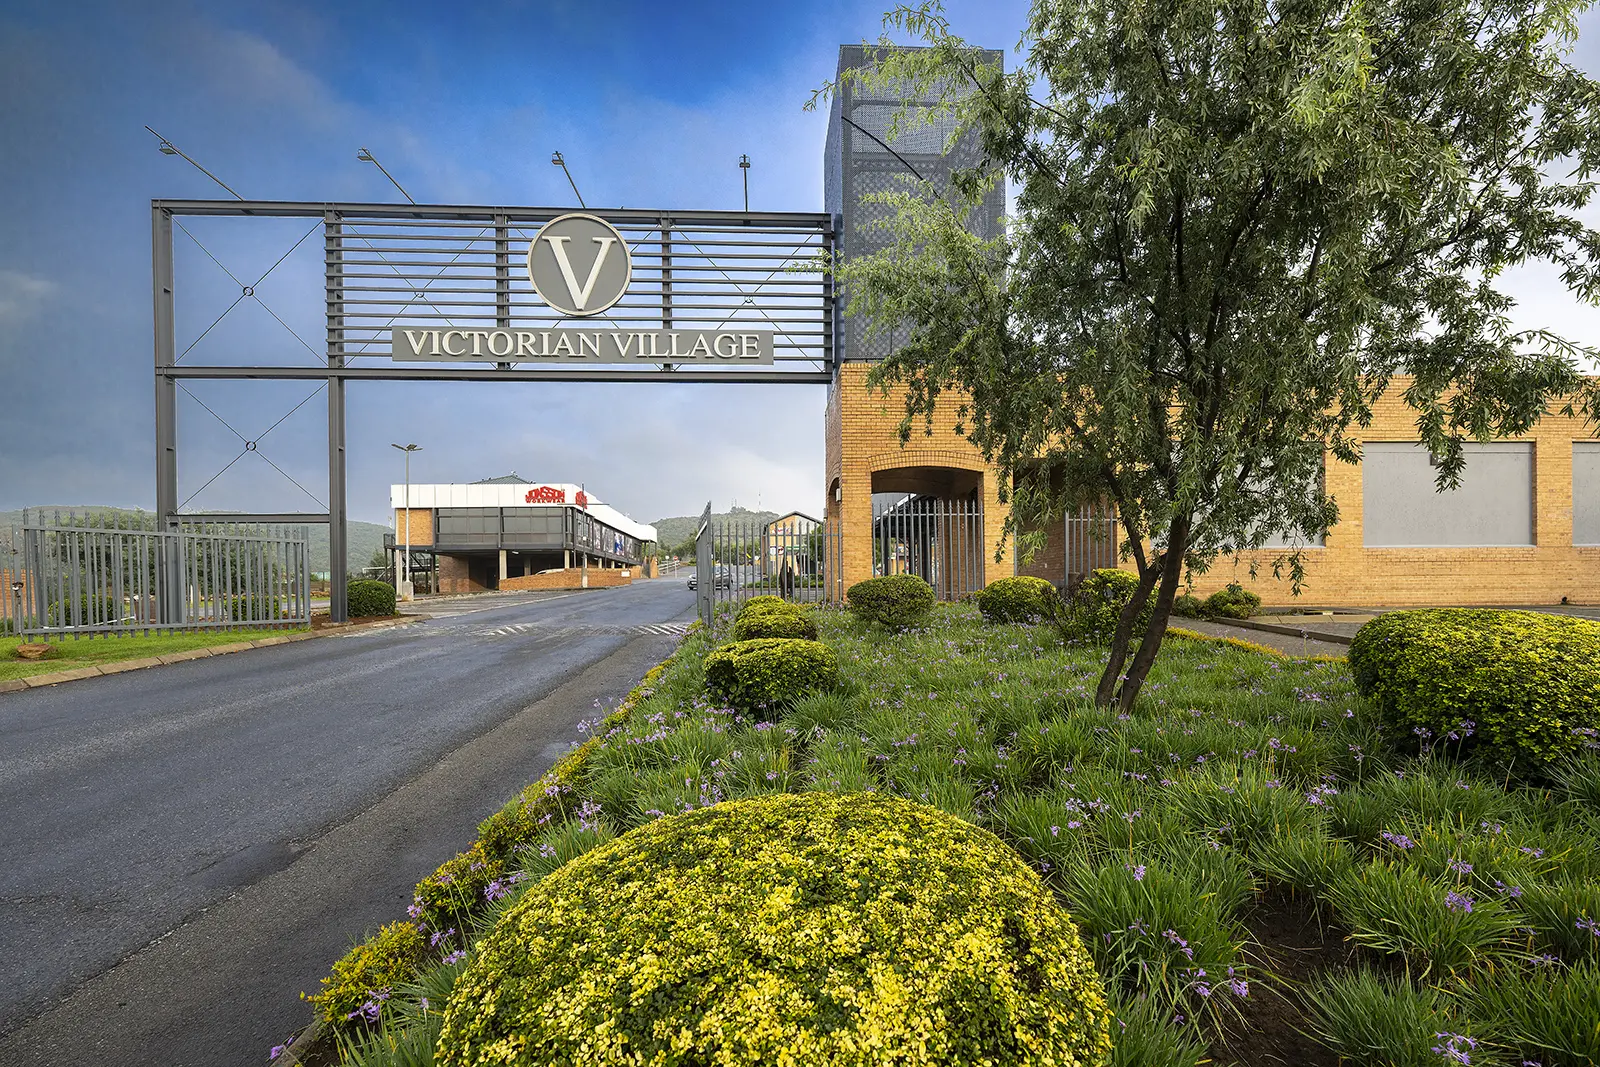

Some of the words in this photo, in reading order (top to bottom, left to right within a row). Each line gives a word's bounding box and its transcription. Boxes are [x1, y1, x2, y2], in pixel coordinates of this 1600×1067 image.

[541, 235, 617, 311] V
[403, 330, 602, 357] VICTORIAN
[610, 332, 762, 359] VILLAGE
[525, 486, 565, 499] JONSSON
